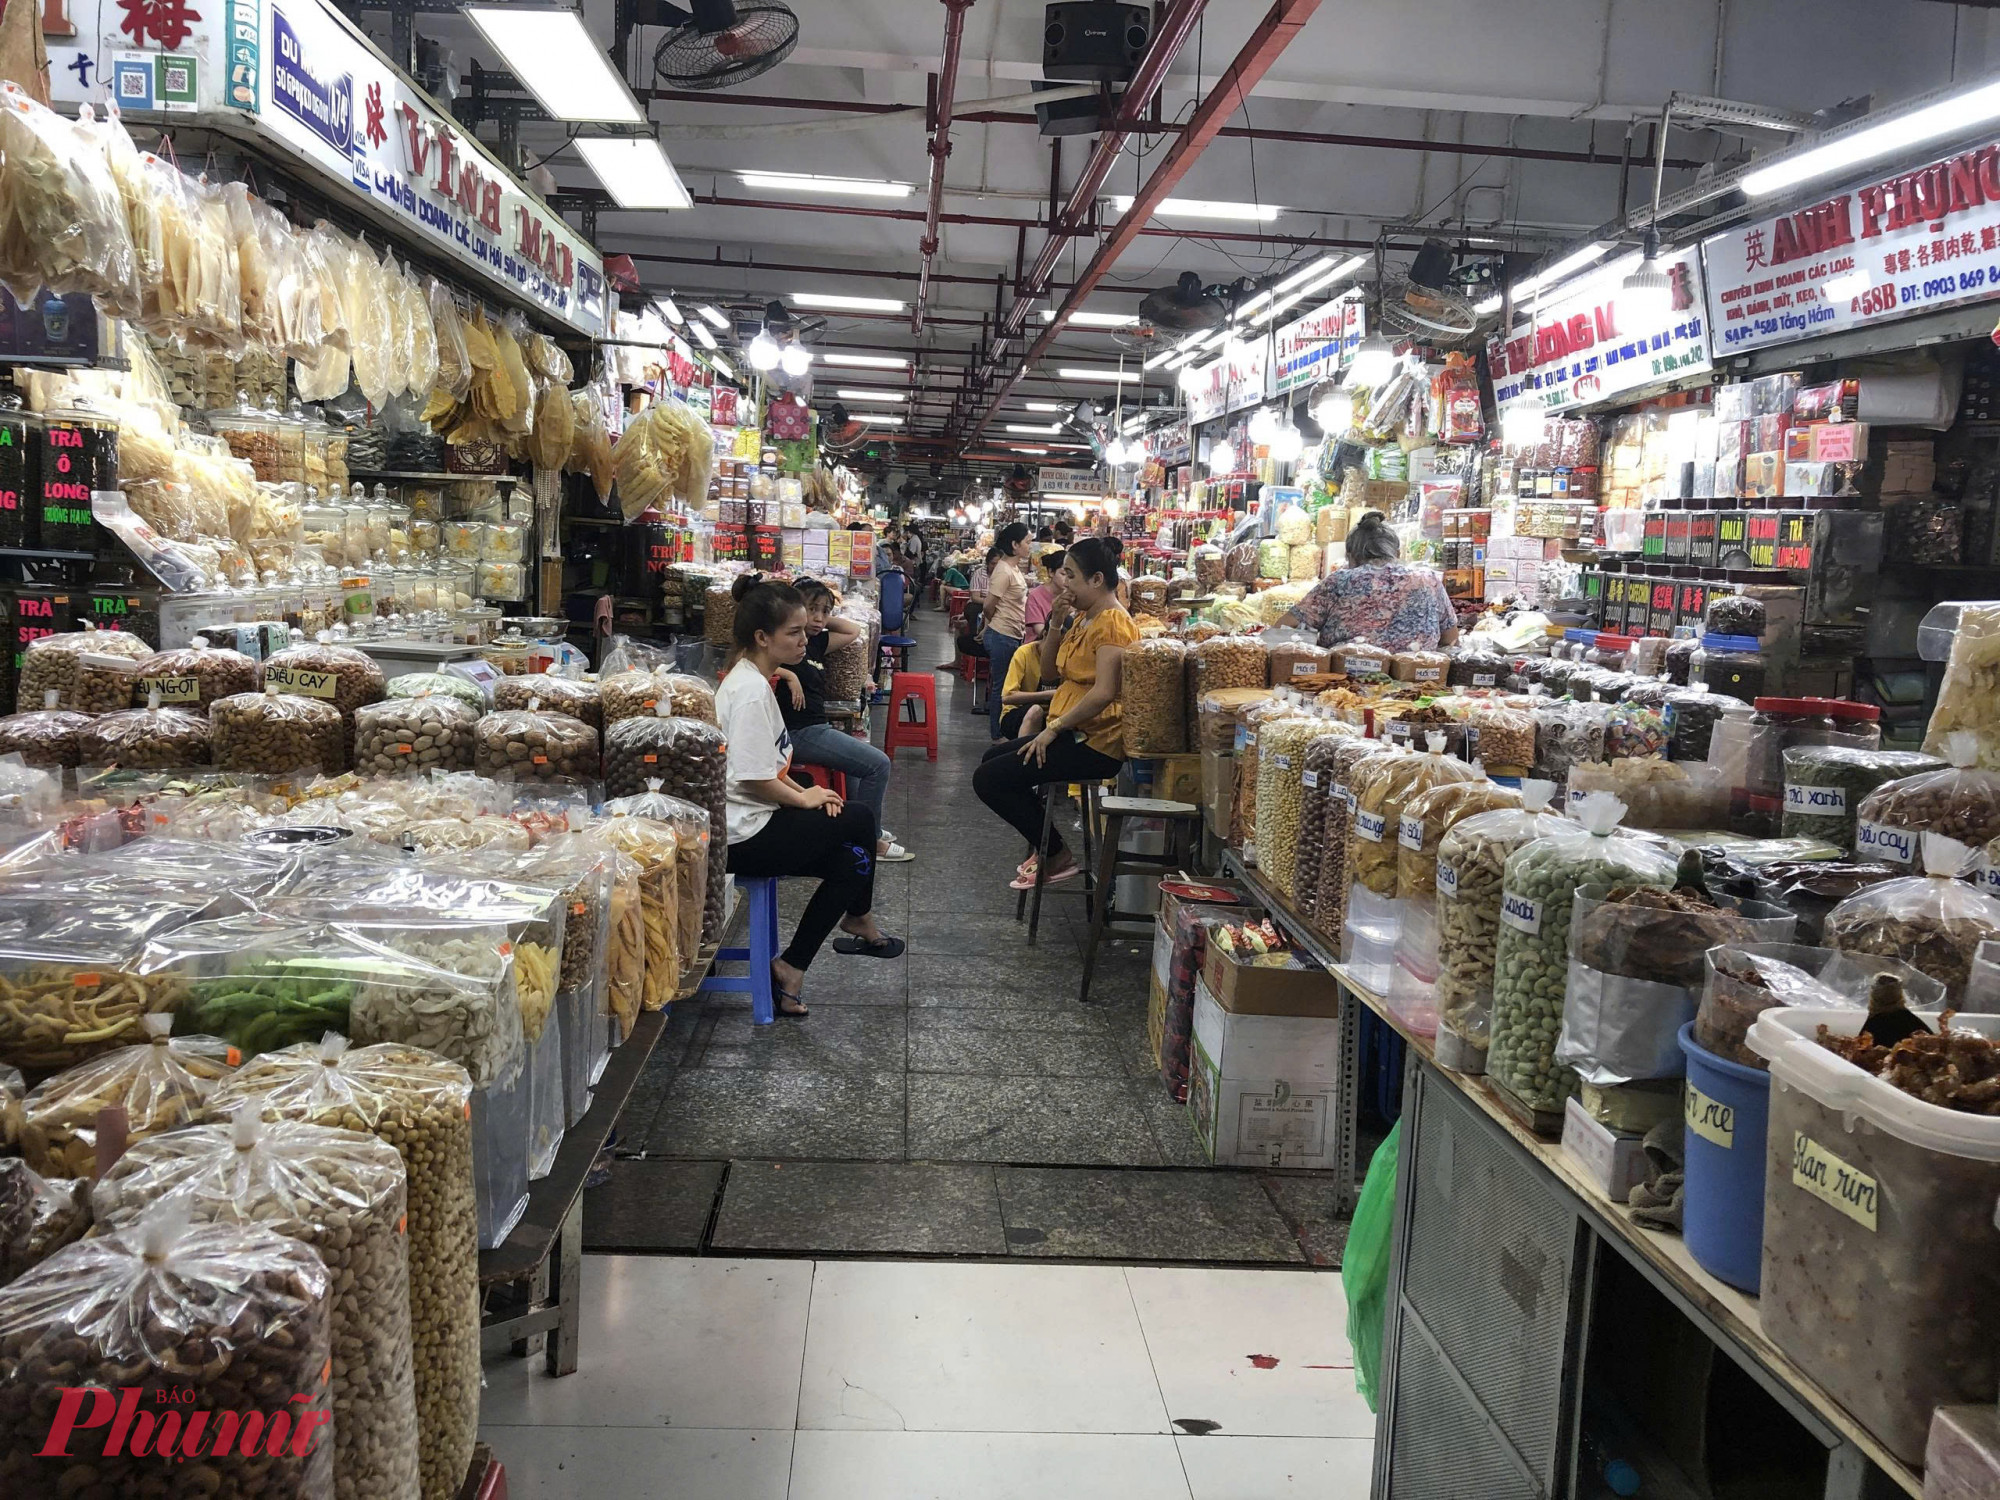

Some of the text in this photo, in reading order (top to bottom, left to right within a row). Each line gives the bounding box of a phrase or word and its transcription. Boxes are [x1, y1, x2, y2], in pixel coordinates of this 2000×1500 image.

[355, 159, 371, 181] VISA
[419, 197, 453, 238] DOANH
[1769, 196, 1856, 266] ANH
[516, 203, 574, 291] MAI
[1808, 262, 1828, 280] CÁC
[1901, 285, 1921, 303] ĐT:
[1923, 276, 1956, 298] 0903
[1959, 268, 1985, 290] 869
[49, 428, 84, 448] TRÀ
[56, 453, 72, 473] Ô
[44, 481, 90, 501] LONG
[19, 597, 54, 617] TRÀ
[93, 595, 128, 614] TRÀ
[156, 678, 197, 697] NGỌT
[299, 672, 329, 689] CAY
[1808, 789, 1844, 807] xanh
[1833, 1167, 1876, 1213] rim
